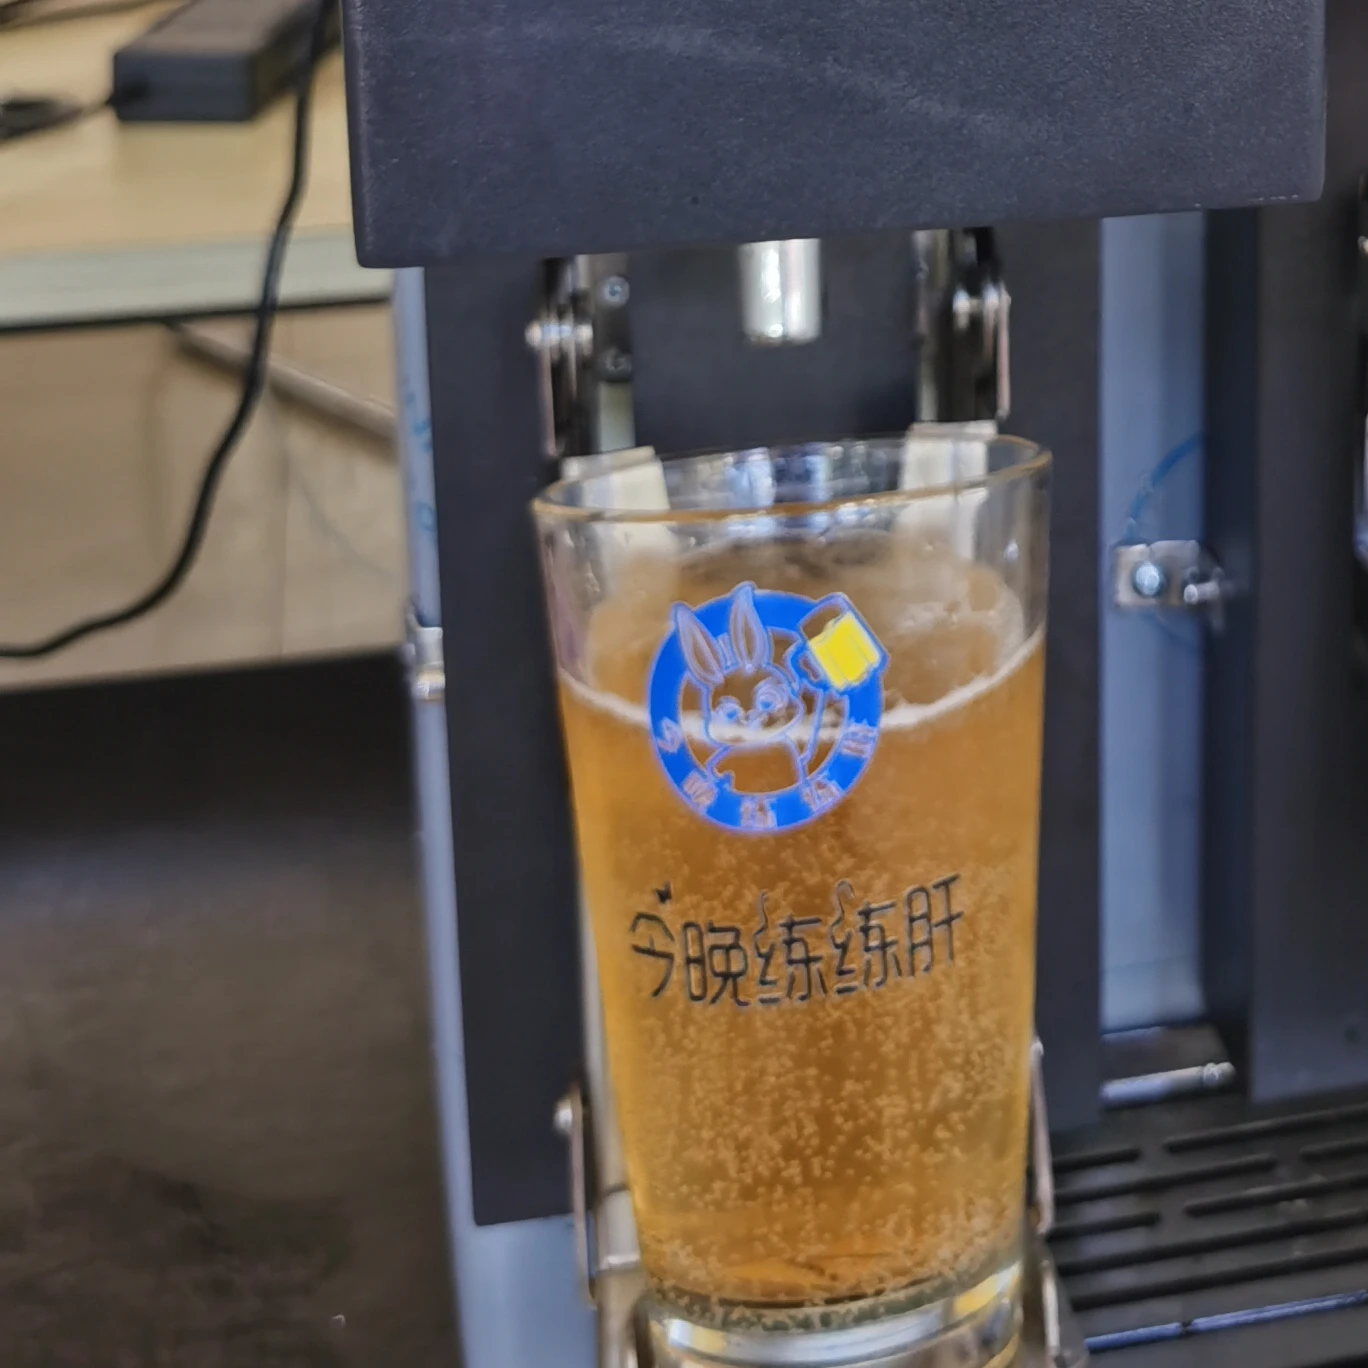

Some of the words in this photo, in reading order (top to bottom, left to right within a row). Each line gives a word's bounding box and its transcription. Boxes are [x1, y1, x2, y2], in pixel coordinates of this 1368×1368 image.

[631, 874, 964, 1006] 今晚练练肝
